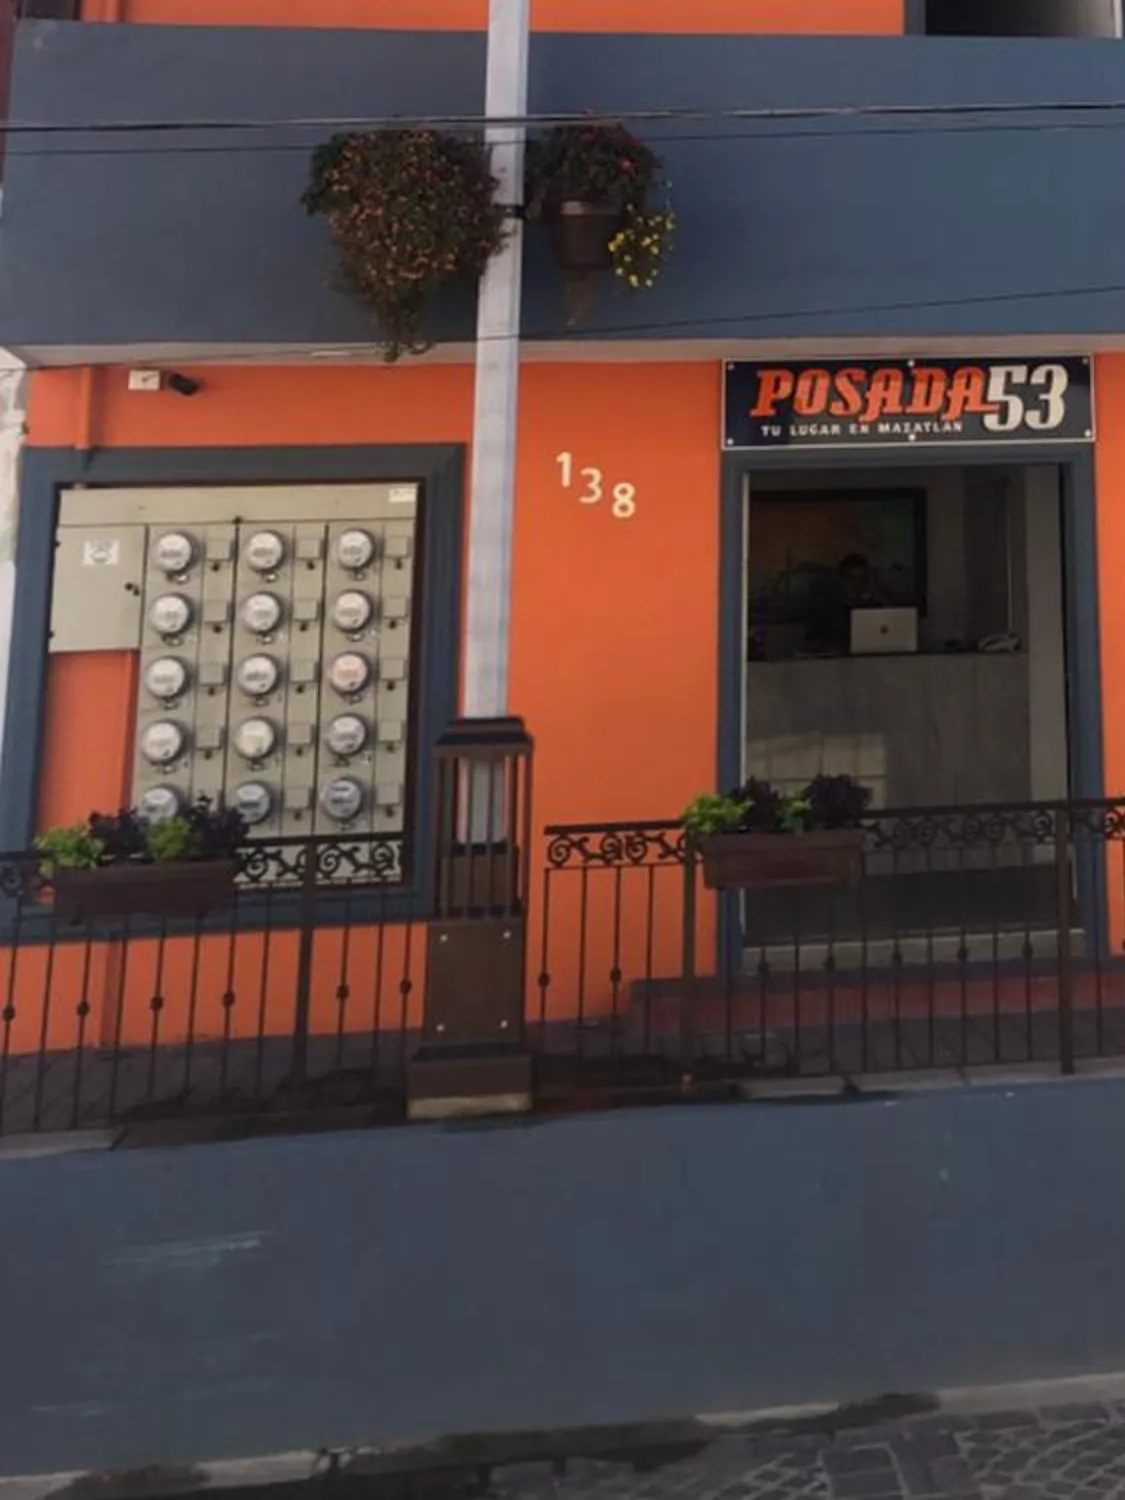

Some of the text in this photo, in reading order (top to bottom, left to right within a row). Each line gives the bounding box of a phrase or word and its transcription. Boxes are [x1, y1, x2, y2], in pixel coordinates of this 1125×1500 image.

[761, 420, 963, 437] TU LUGAR EN MAZATLAN
[556, 451, 637, 518] 138
